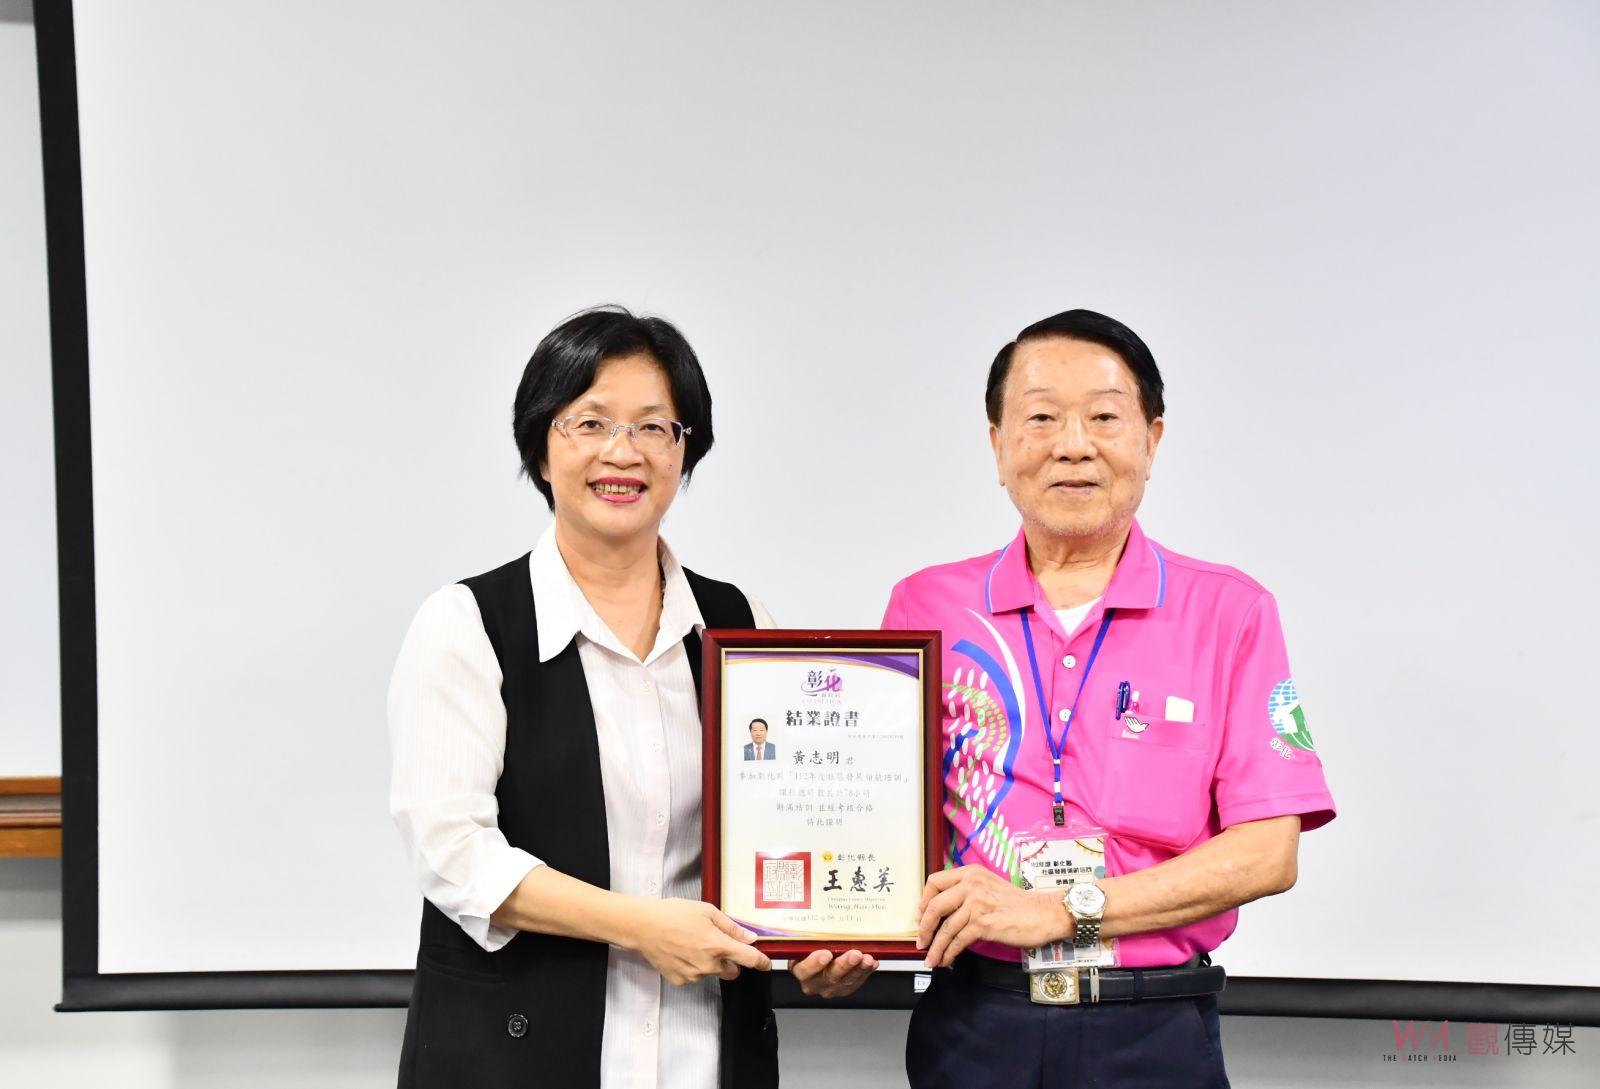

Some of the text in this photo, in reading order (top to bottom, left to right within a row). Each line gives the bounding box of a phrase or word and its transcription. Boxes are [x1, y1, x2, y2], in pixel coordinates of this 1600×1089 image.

[806, 668, 843, 692] 彰化
[786, 709, 859, 727] 結業證書
[793, 750, 840, 766] 黃志明
[837, 853, 876, 862] 彰化縣長
[823, 866, 894, 892] 王惠美
